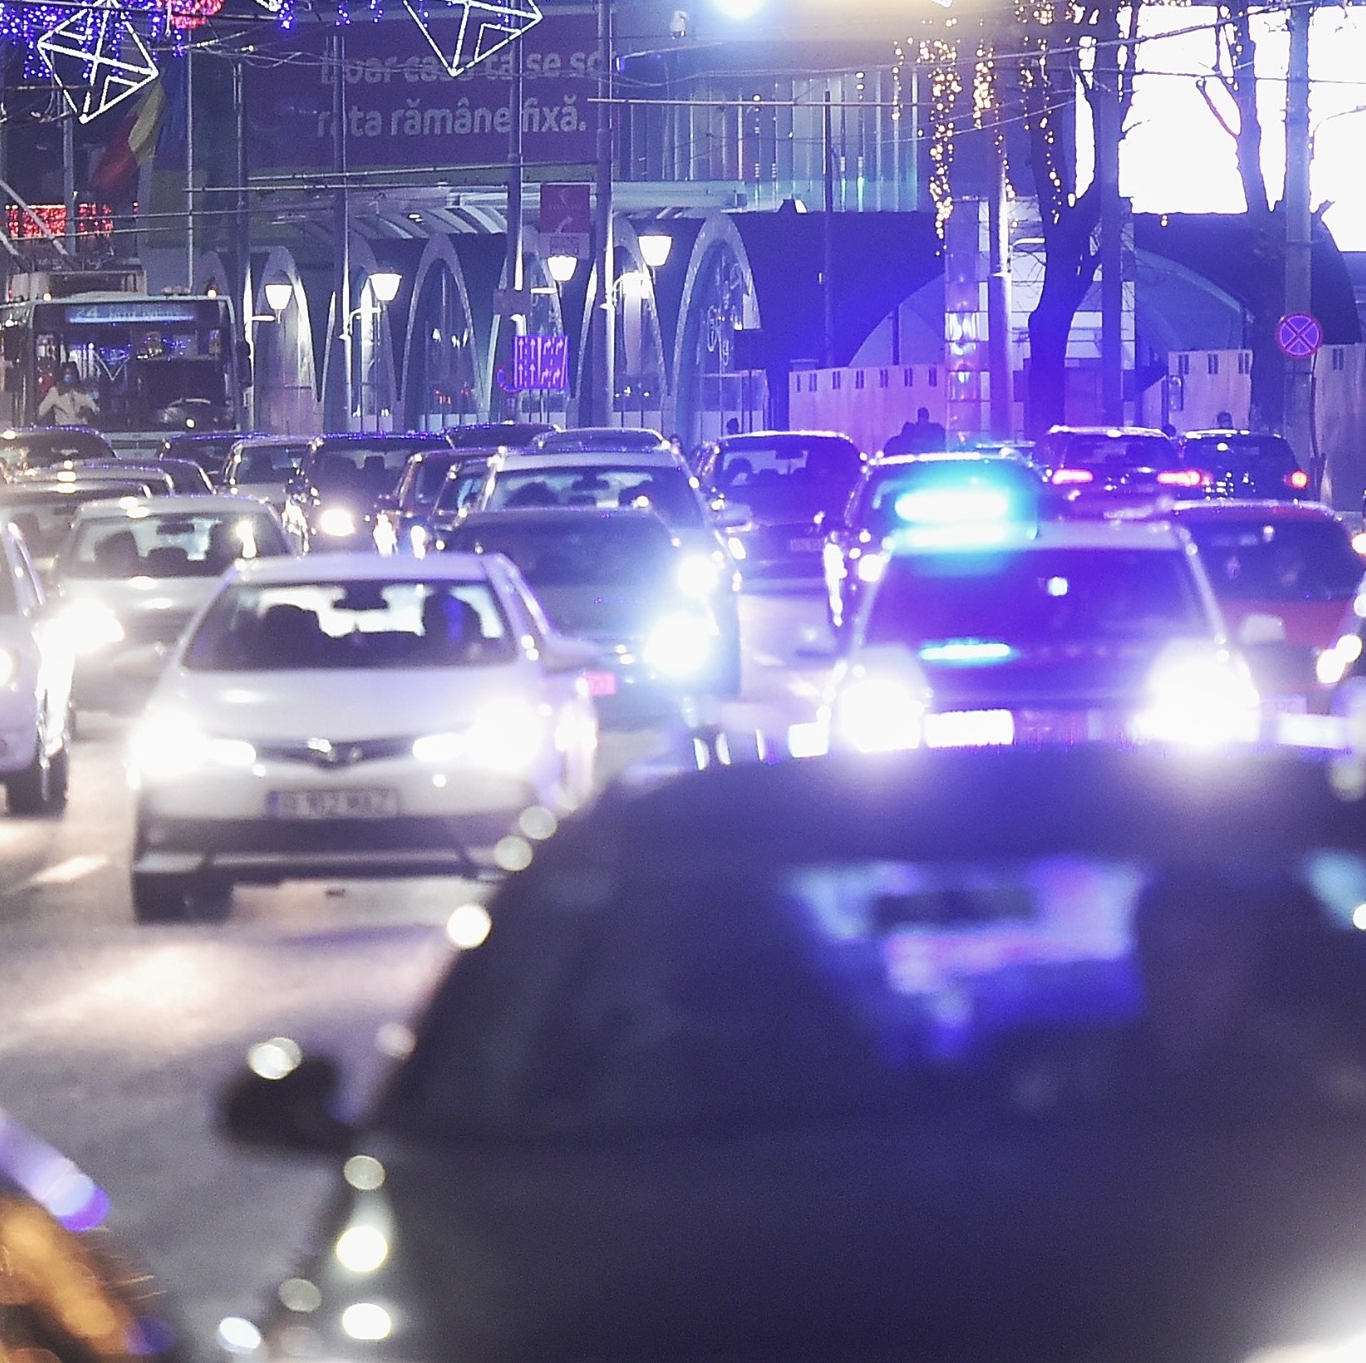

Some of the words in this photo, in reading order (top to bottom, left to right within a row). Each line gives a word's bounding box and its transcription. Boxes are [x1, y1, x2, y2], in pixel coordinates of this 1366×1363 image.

[525, 52, 561, 79] se
[390, 97, 511, 136] rămâne
[522, 94, 586, 133] fixă.
